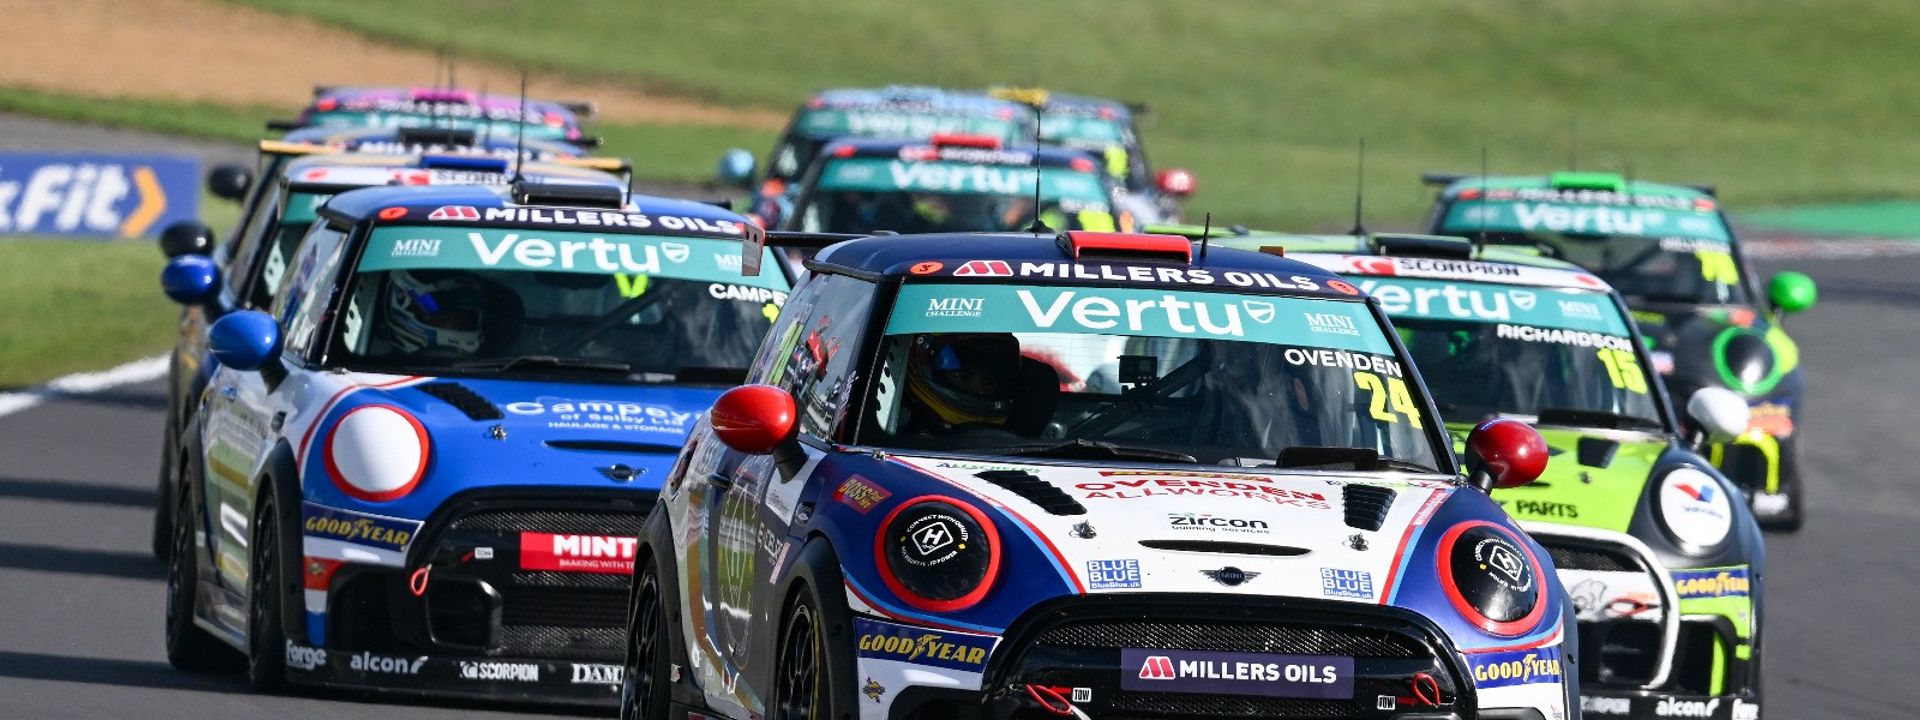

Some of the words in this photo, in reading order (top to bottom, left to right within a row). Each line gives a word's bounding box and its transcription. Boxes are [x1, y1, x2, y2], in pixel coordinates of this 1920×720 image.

[890, 160, 1021, 193] Vertu
[485, 208, 652, 228] MILLERS
[658, 215, 741, 234] OILS
[1513, 203, 1643, 235] Vertu
[393, 239, 442, 251] MINI
[468, 232, 661, 274] Vertu
[1400, 258, 1520, 276] SCORPION
[1020, 262, 1215, 287] MILLERS
[1223, 272, 1320, 292] OILS
[927, 298, 985, 311] MINI
[1016, 289, 1245, 337] Vertu
[1304, 312, 1355, 329] MINI
[1310, 326, 1361, 337] CHALLENGE
[1497, 323, 1635, 353] RICHARDSON
[1284, 348, 1403, 378] OVENDEN
[1597, 347, 1648, 395] 15
[1353, 371, 1424, 430] 24
[548, 421, 612, 431] HAULAGE
[624, 424, 685, 434] STORAGE
[588, 414, 645, 424] Selby
[1075, 478, 1326, 502] OVENDEN
[1086, 487, 1333, 510] ALLWORKS
[1516, 500, 1579, 518] PARTS
[306, 516, 410, 545] GOODYEAR
[1169, 513, 1269, 530] zircon
[1171, 523, 1216, 533] building
[1221, 526, 1270, 535] services
[553, 534, 638, 558] MINT
[922, 528, 944, 546] H
[477, 548, 493, 558] TOW
[559, 558, 599, 568] BRAKING
[601, 560, 624, 569] WITH
[1089, 560, 1138, 571] BLUE
[1090, 571, 1140, 582] BLUE
[1322, 568, 1372, 581] BLUE
[1323, 579, 1373, 592] BLUE
[1324, 588, 1373, 599] BlueBlue.uk
[859, 634, 986, 665] GOODYEAR
[351, 651, 408, 673] alcon
[1179, 659, 1281, 682] MILLERS
[1285, 663, 1338, 684] OILS
[1475, 654, 1561, 683] GOODYEAR
[478, 662, 539, 682] SCORPION
[1074, 688, 1091, 701] TOW
[1379, 695, 1396, 708] TOW
[1655, 696, 1704, 717] alcon
